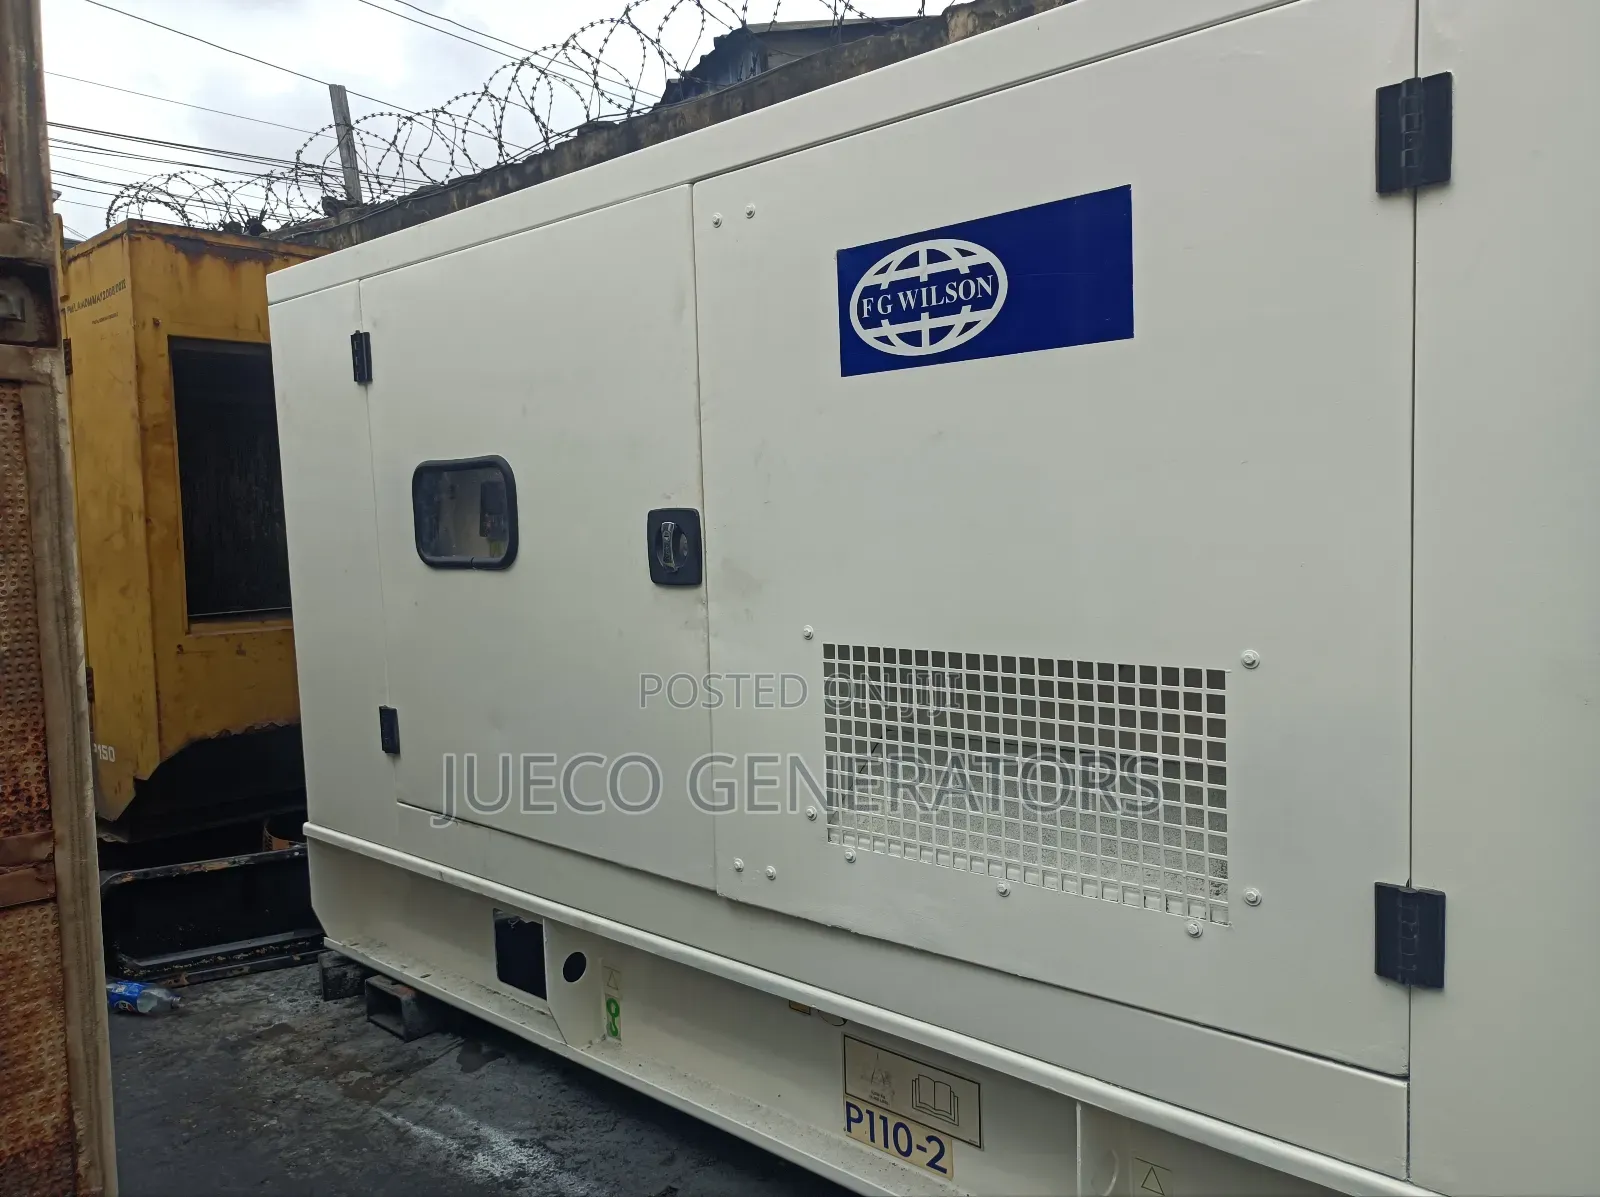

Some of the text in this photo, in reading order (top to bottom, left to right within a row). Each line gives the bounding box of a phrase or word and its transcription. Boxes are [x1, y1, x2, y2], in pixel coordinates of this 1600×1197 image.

[861, 275, 994, 318] FG WILSON
[846, 1101, 947, 1174] P110-2
